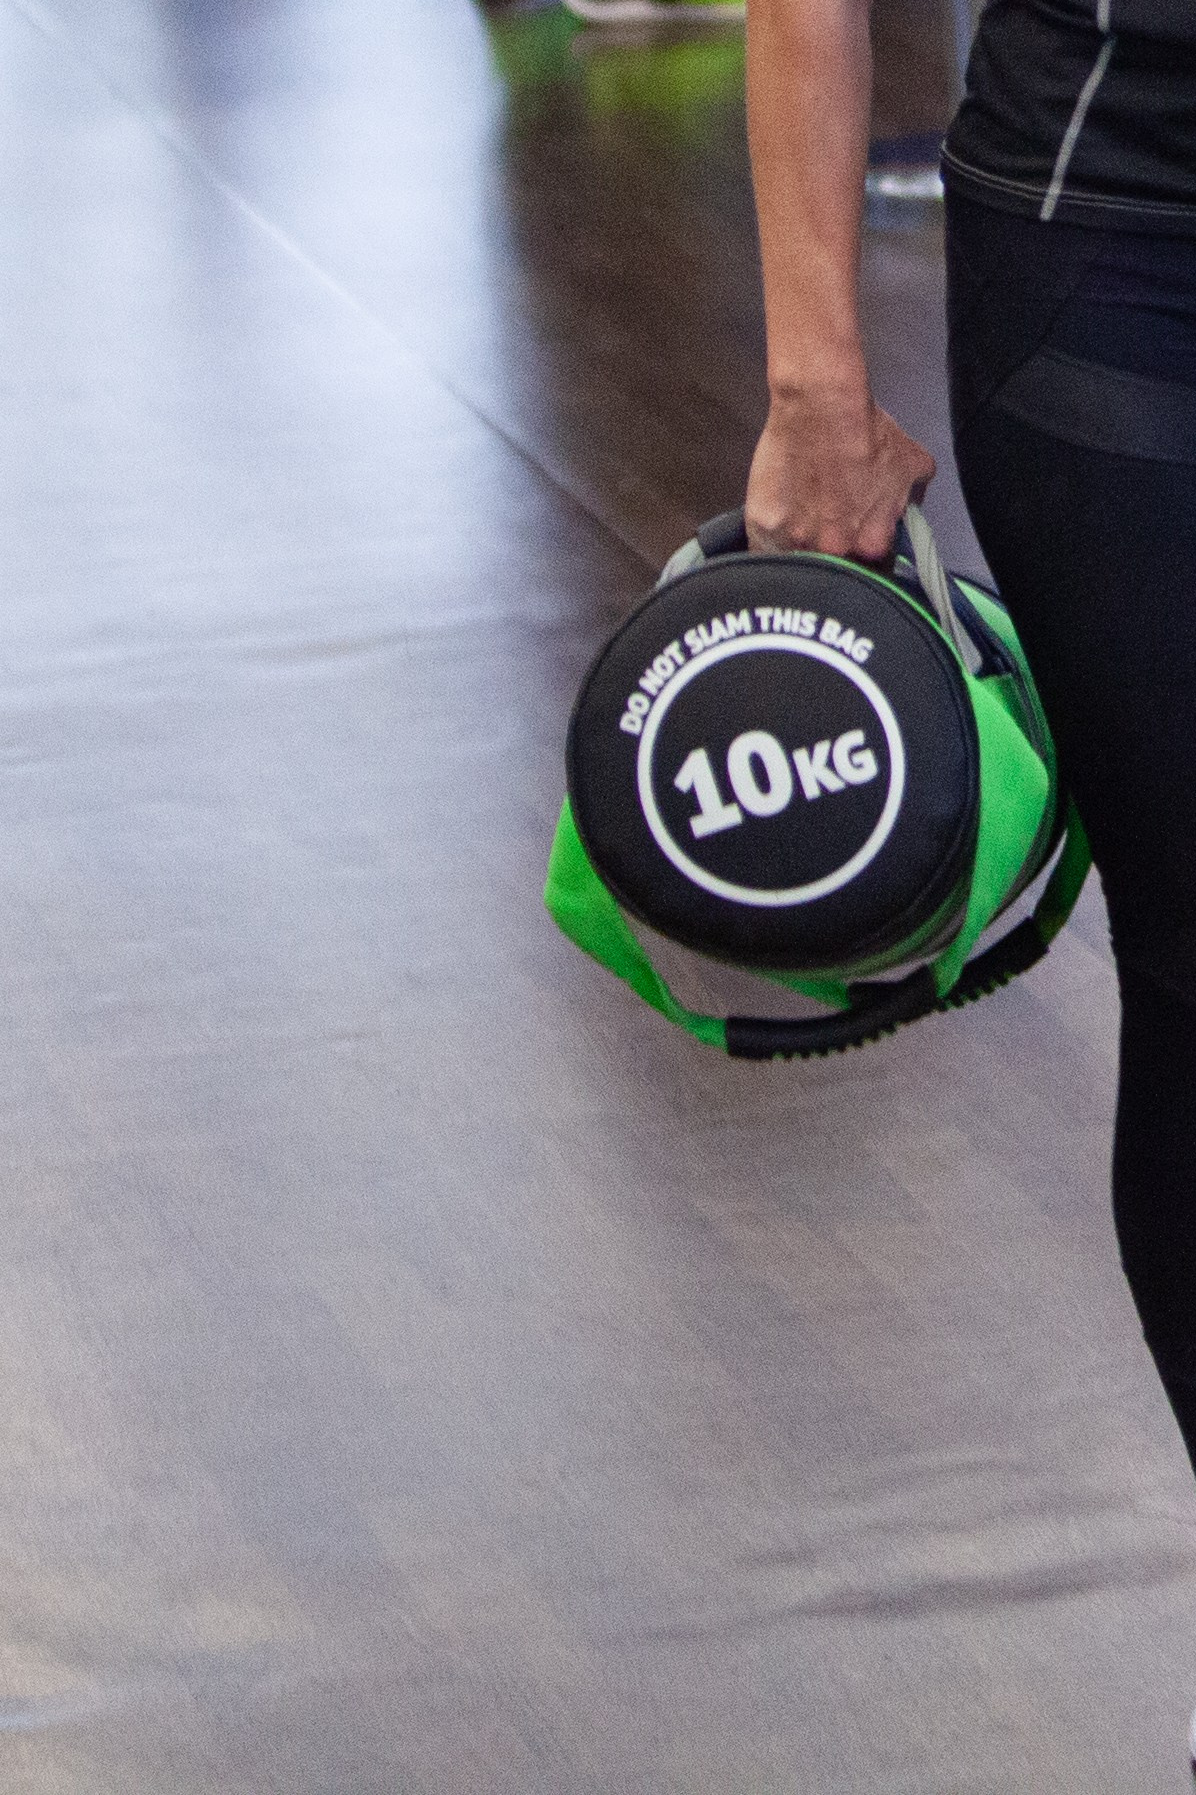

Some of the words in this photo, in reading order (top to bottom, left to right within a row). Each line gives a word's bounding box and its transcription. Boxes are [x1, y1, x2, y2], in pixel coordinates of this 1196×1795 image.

[619, 692, 651, 736] DO
[638, 640, 686, 697] NOT
[683, 608, 752, 656] SLAM
[754, 606, 818, 638] THIS
[819, 617, 875, 664] BAG
